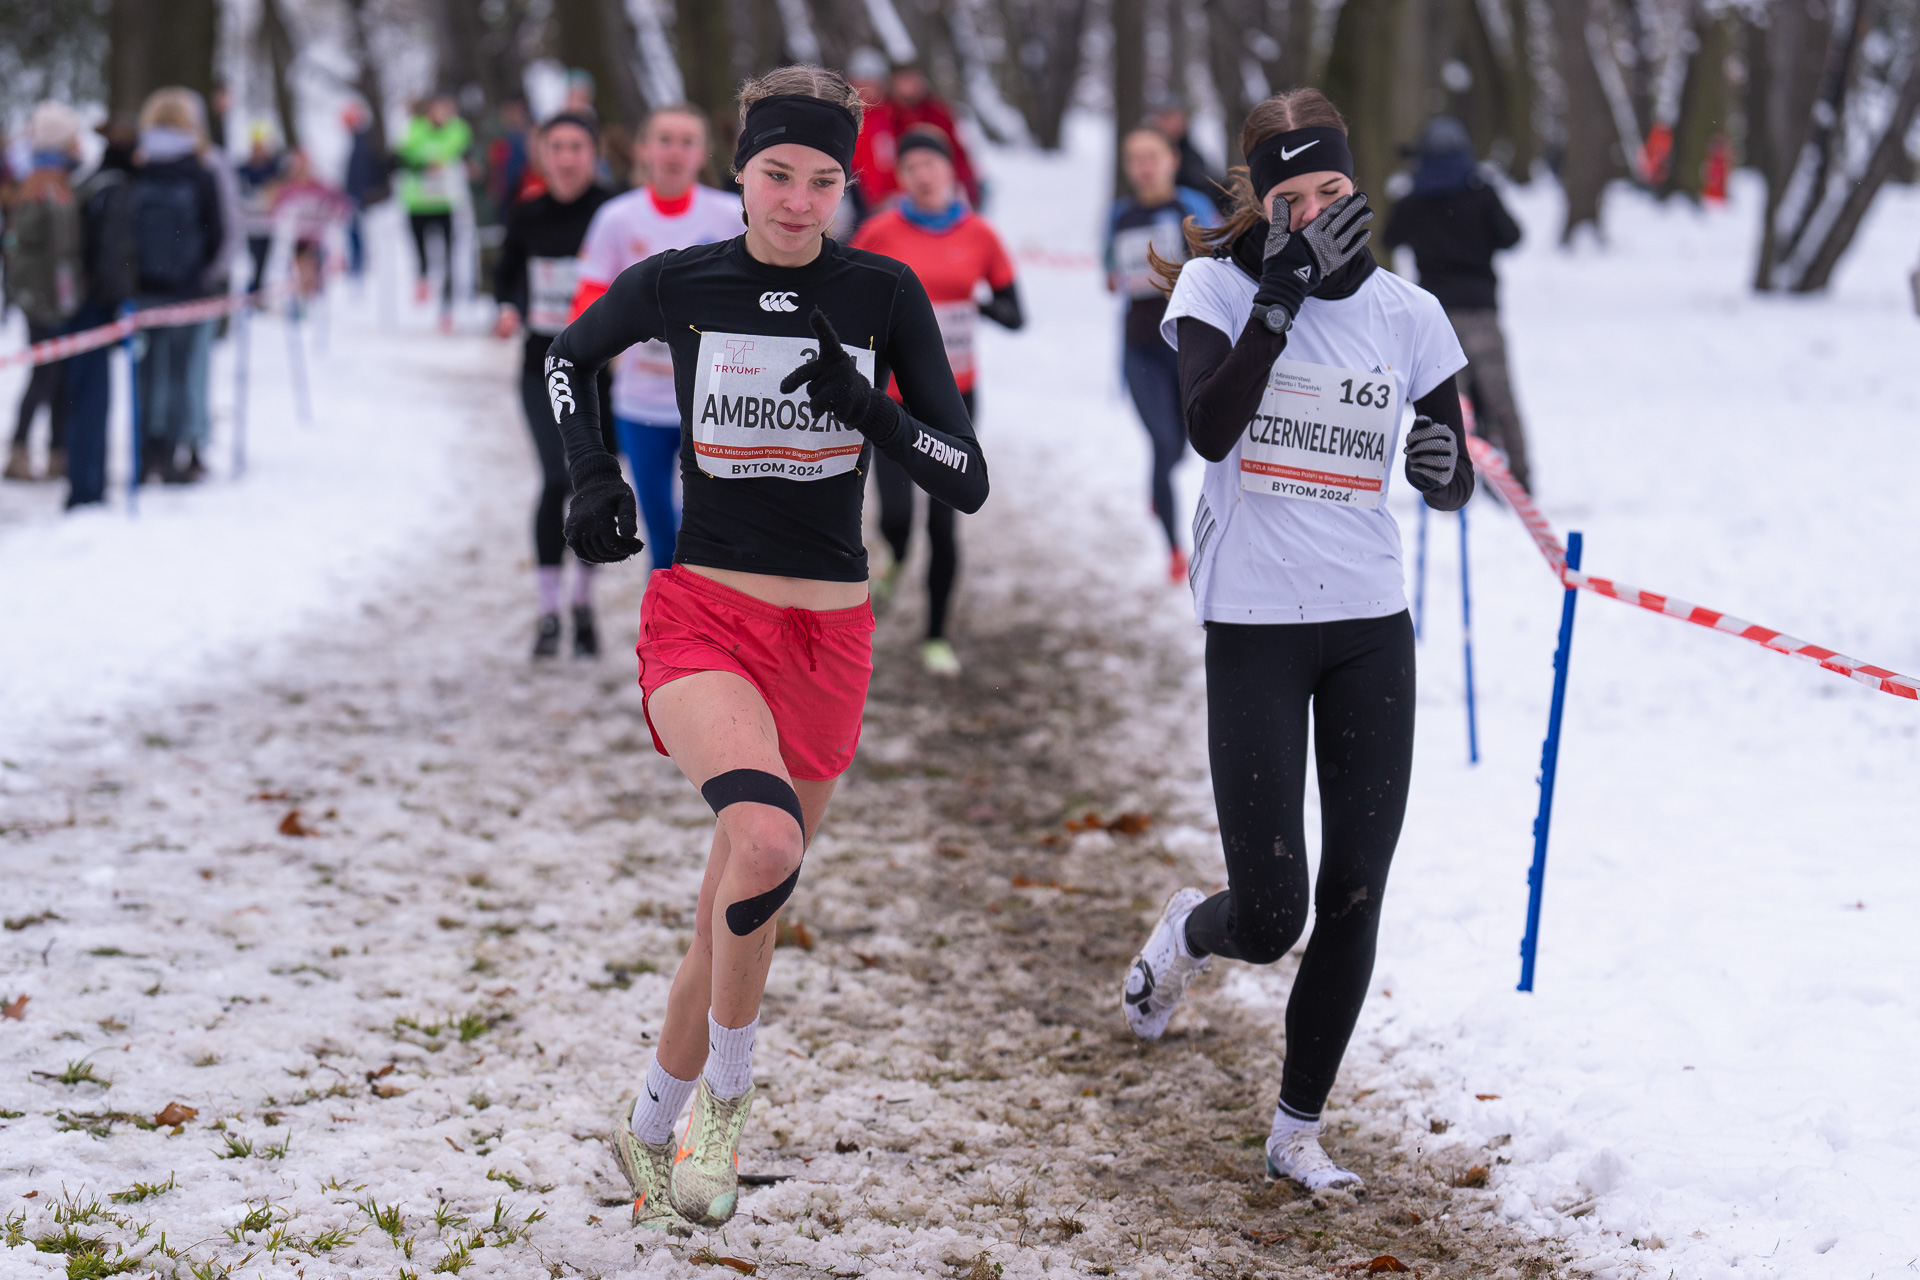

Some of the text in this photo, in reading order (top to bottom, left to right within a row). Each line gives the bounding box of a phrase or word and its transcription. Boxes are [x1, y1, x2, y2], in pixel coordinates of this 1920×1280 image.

[714, 364, 761, 375] TRYUMF
[1275, 372, 1312, 383] Ministerstwo
[1275, 379, 1293, 387] Sportu
[1297, 382, 1322, 392] Turystyki
[1339, 378, 1391, 409] 163
[1249, 413, 1386, 462] CZERNIELEWSKA
[724, 448, 763, 456] Mistrzostwa
[912, 430, 968, 473] LANGLEY
[731, 462, 823, 476] BYTOM 2024
[1271, 481, 1350, 502] BYTOM 2024
